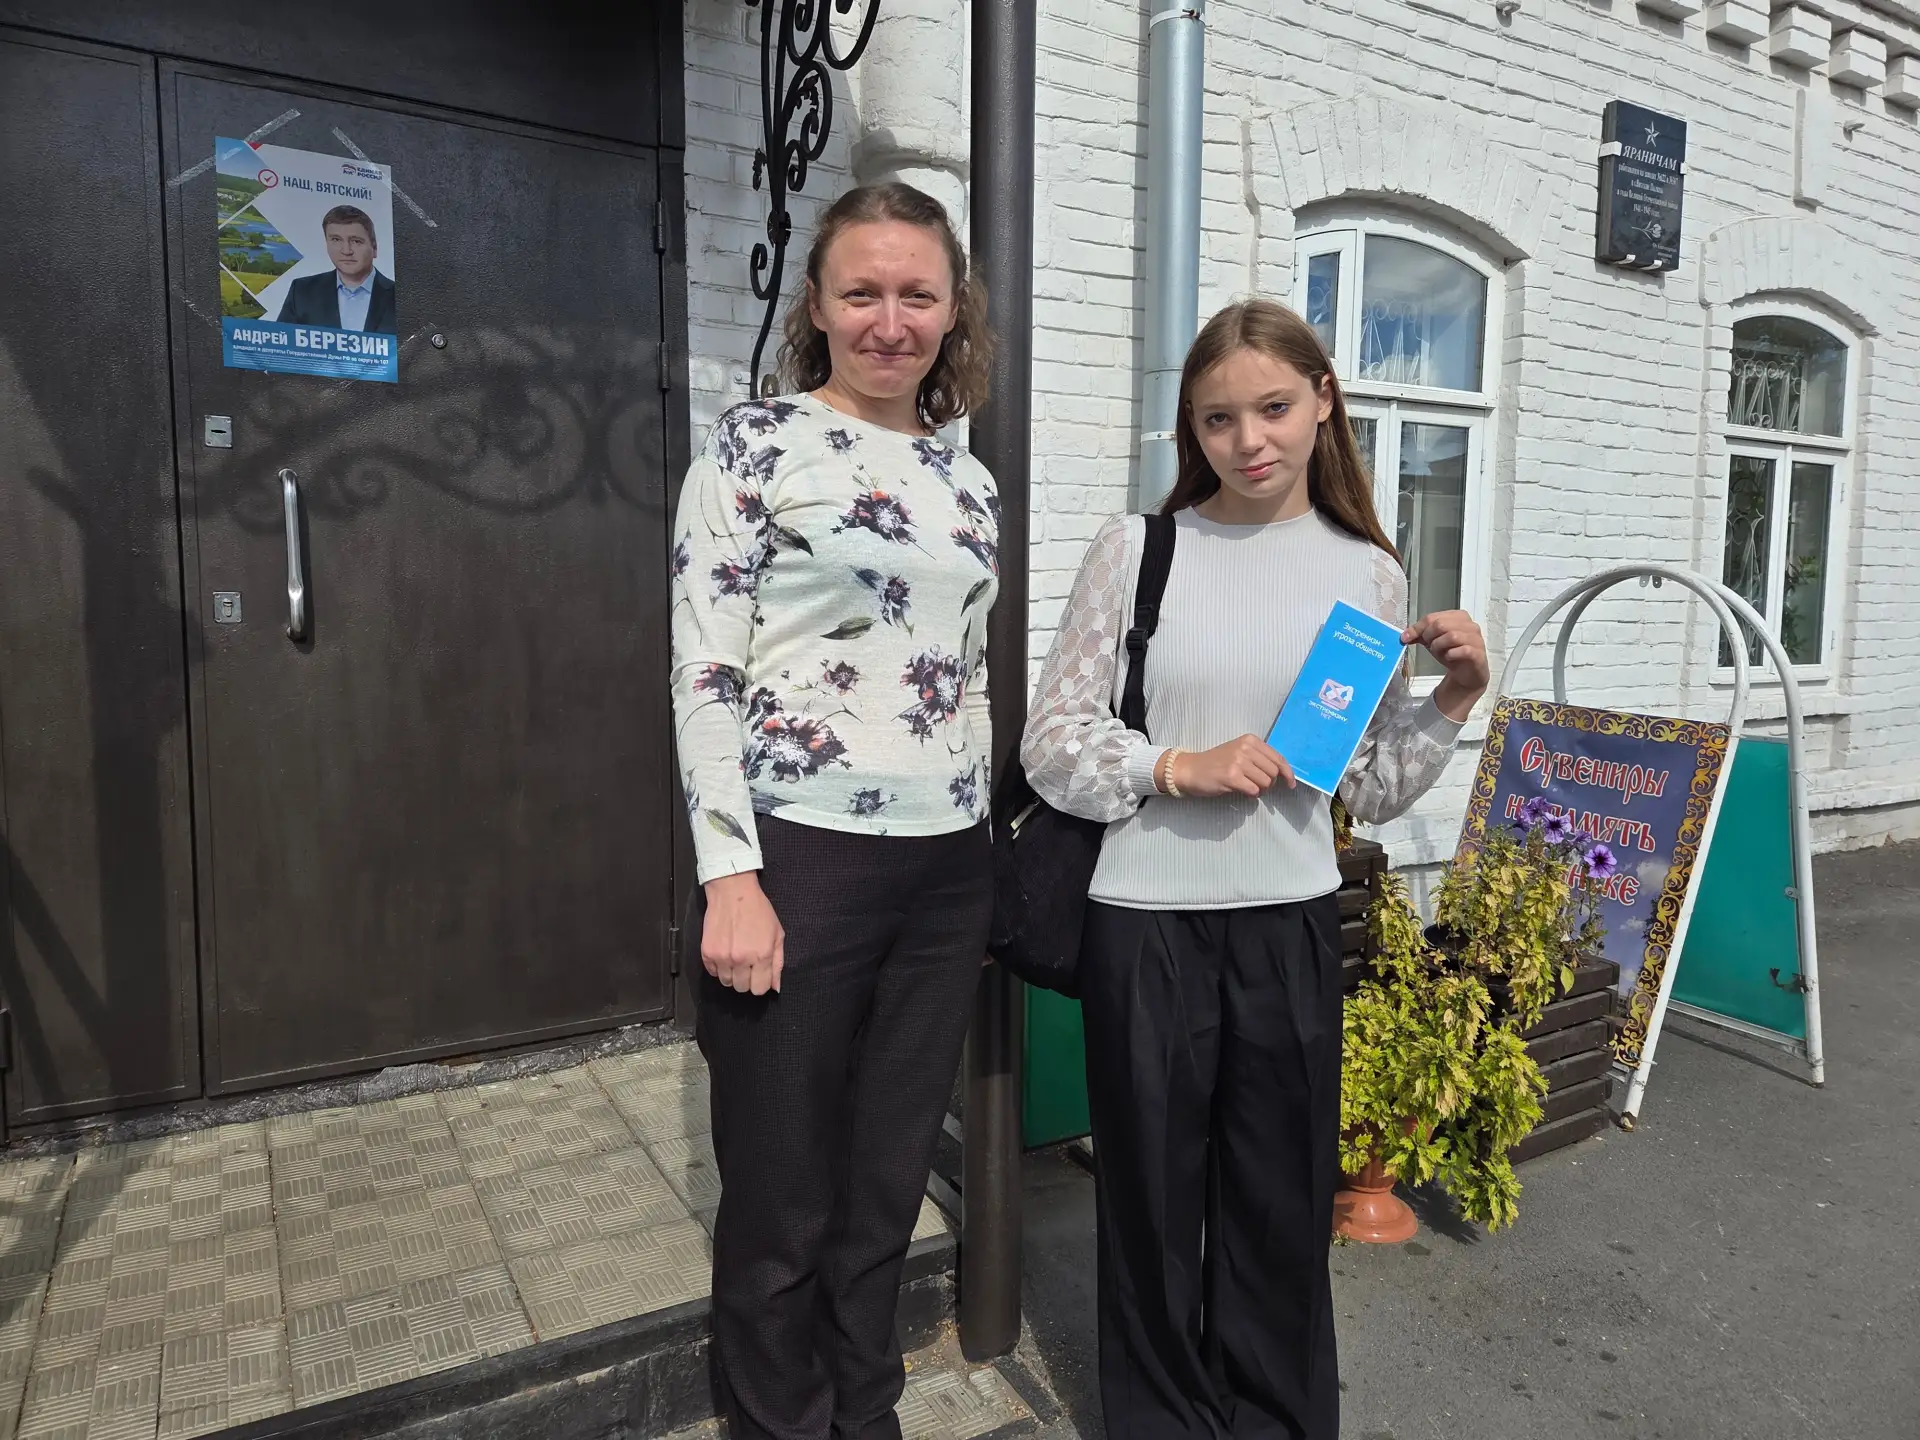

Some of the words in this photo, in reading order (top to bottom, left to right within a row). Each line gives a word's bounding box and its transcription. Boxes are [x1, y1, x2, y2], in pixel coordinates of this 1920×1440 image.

[1622, 145, 1678, 171] ЯРАНИЧАМ
[283, 175, 313, 192] НАШ,
[316, 181, 373, 201] ВЯТСКИЙ!
[233, 328, 288, 346] АНДРЕЙ
[295, 328, 389, 356] БЕРЕЗИН
[1333, 630, 1356, 645] угроза
[1355, 641, 1386, 661] обществу
[1343, 621, 1381, 646] Экстремизм
[1521, 737, 1669, 804] Сувениры
